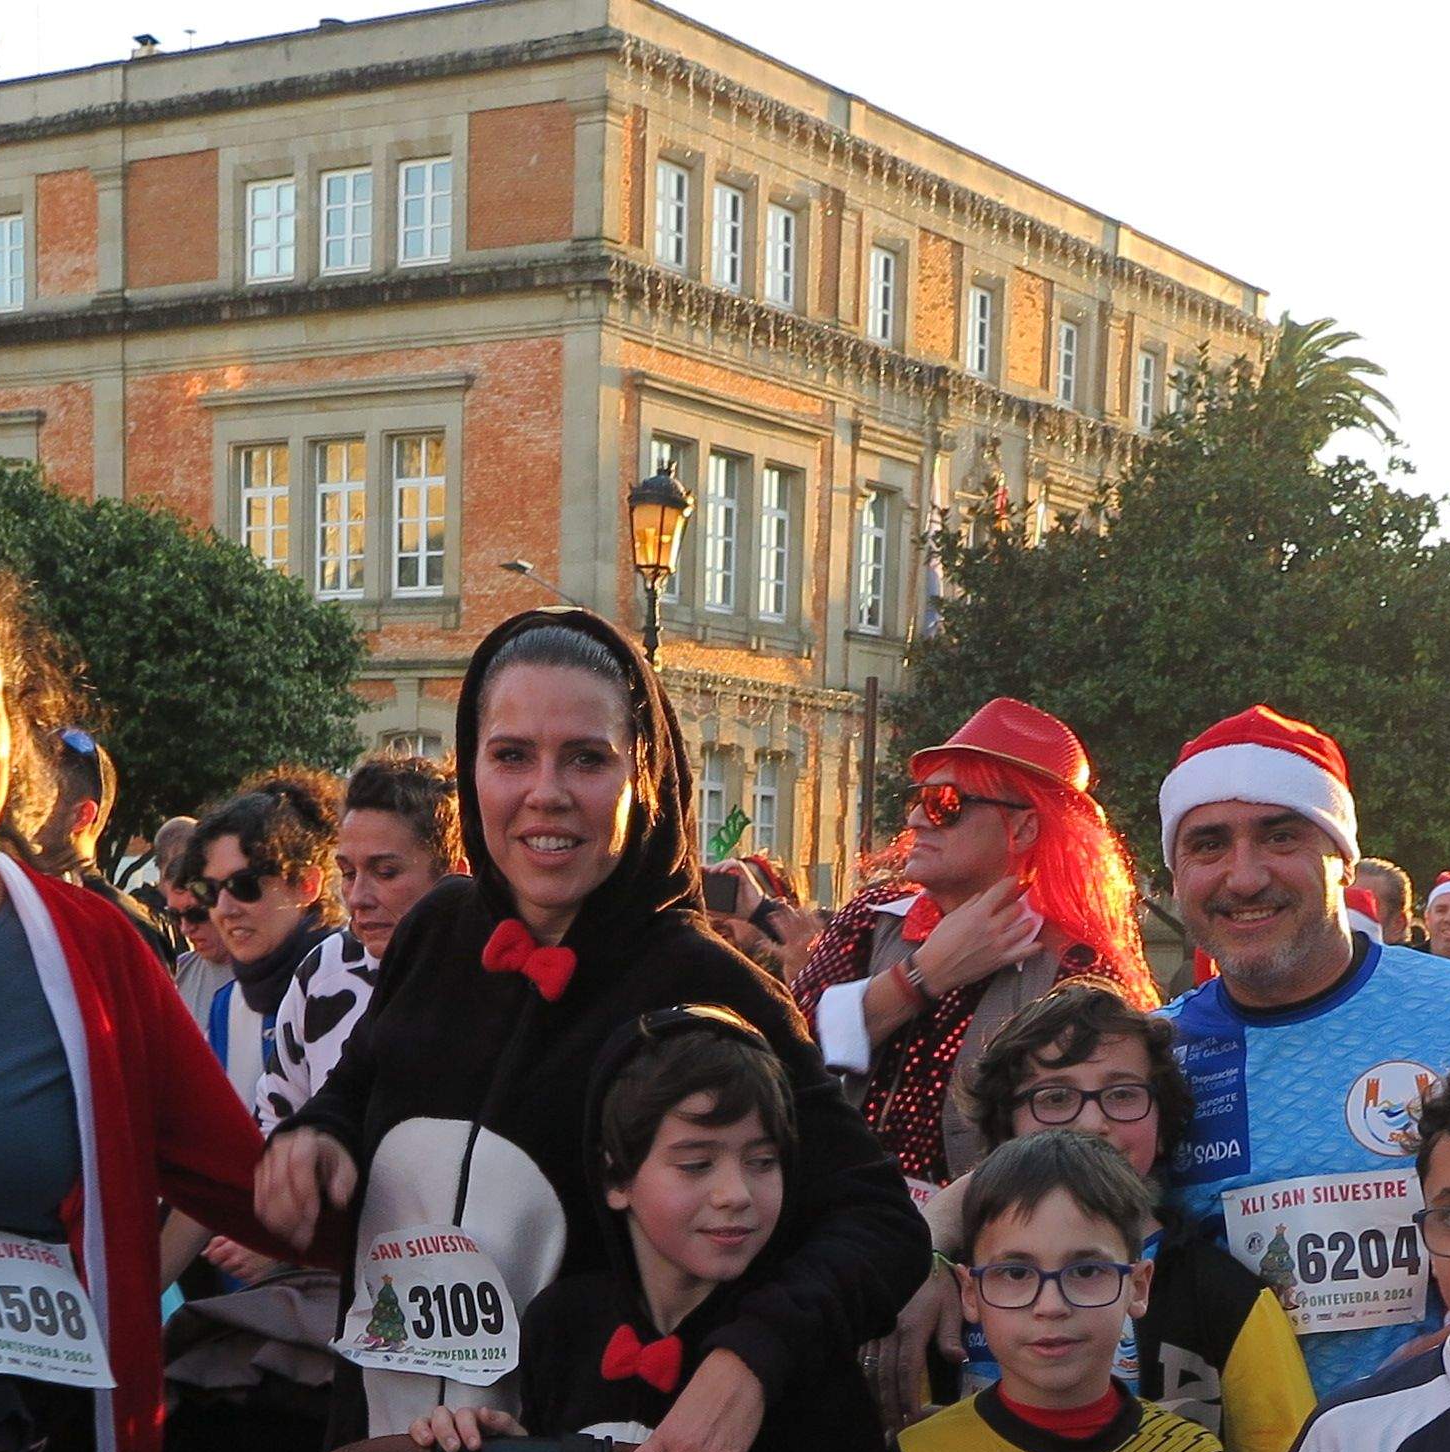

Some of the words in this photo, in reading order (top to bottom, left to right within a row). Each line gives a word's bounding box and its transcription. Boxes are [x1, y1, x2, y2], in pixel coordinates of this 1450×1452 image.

[1194, 1139, 1241, 1165] SADA
[1240, 1196, 1266, 1216] XLI
[1272, 1188, 1306, 1210] SAN
[1312, 1179, 1408, 1204] SILVESTRE
[1297, 1225, 1421, 1285] 6204
[407, 1281, 505, 1340] 3109
[1301, 1290, 1380, 1308] PONTEVEDRA
[1384, 1287, 1414, 1301] 2024
[482, 1346, 507, 1360] 2024
